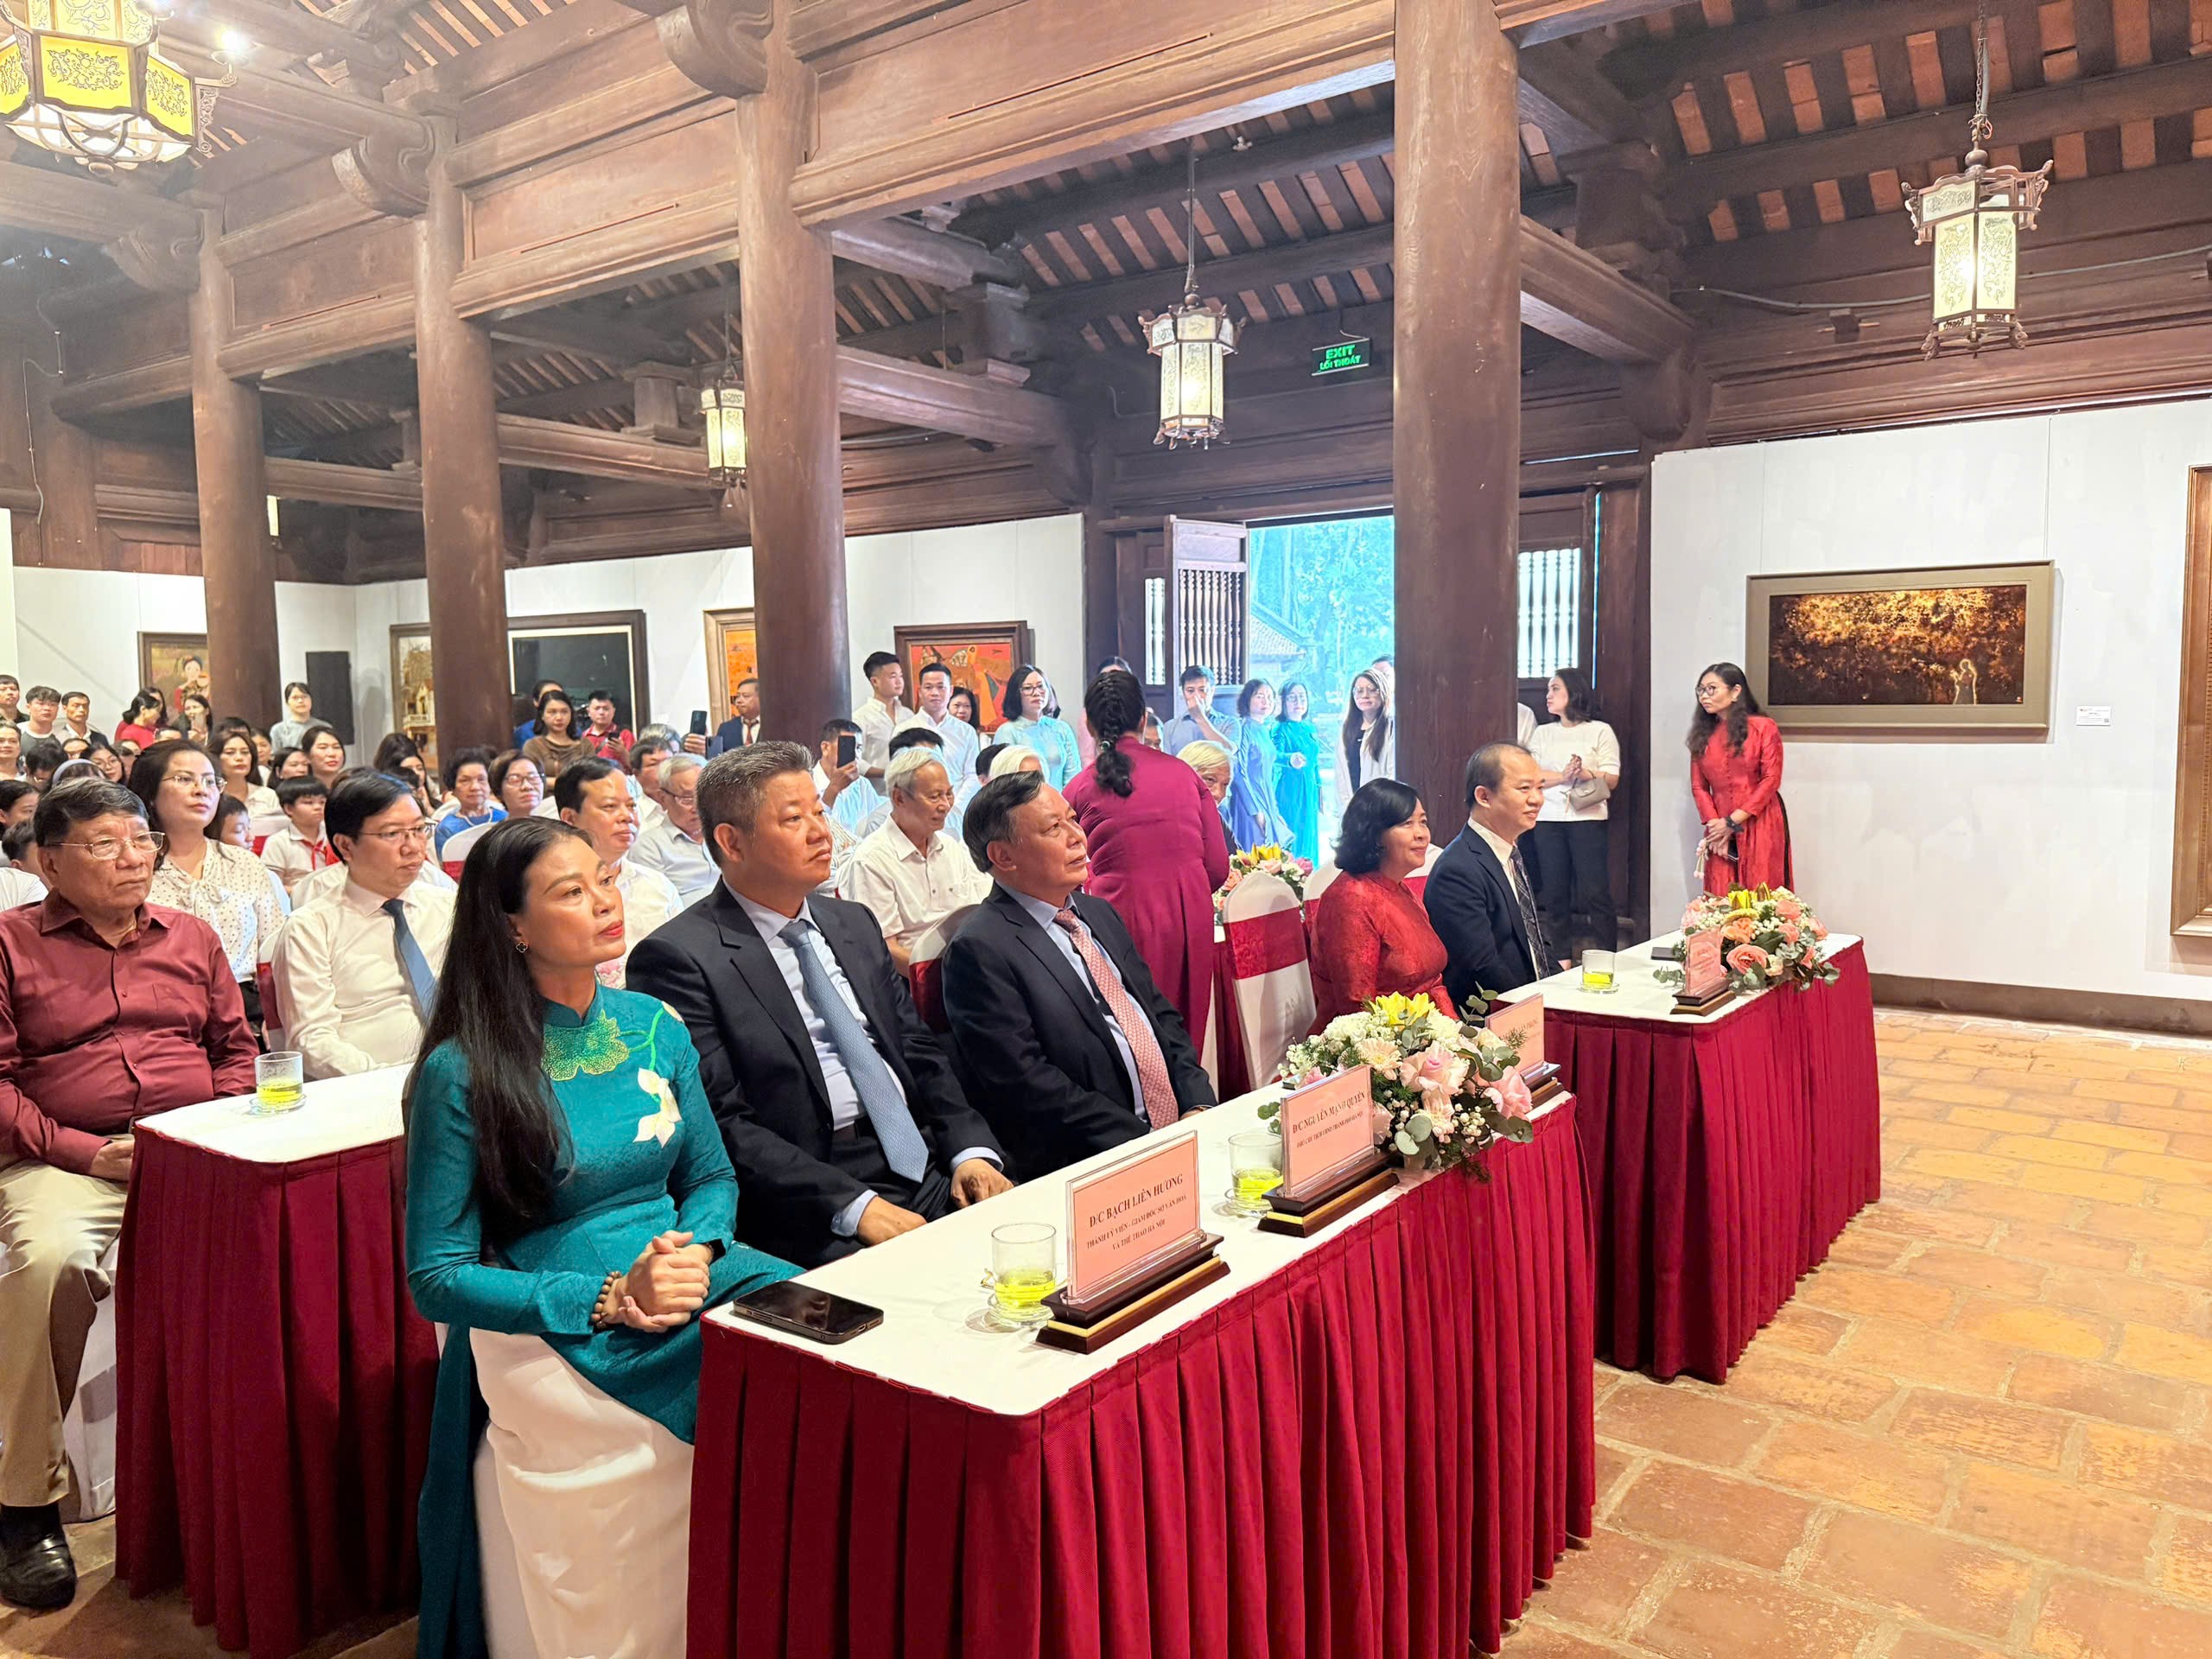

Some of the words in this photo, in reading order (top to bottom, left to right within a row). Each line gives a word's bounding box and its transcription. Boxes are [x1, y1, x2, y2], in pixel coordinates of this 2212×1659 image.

[1326, 345, 1355, 359] EXIT
[1319, 359, 1332, 371] LỐI
[1333, 355, 1361, 367] THOÁT
[1106, 1198, 1131, 1219] BẠCH
[1132, 1188, 1152, 1207] LIÊN
[1154, 1173, 1183, 1197] HƯƠNG
